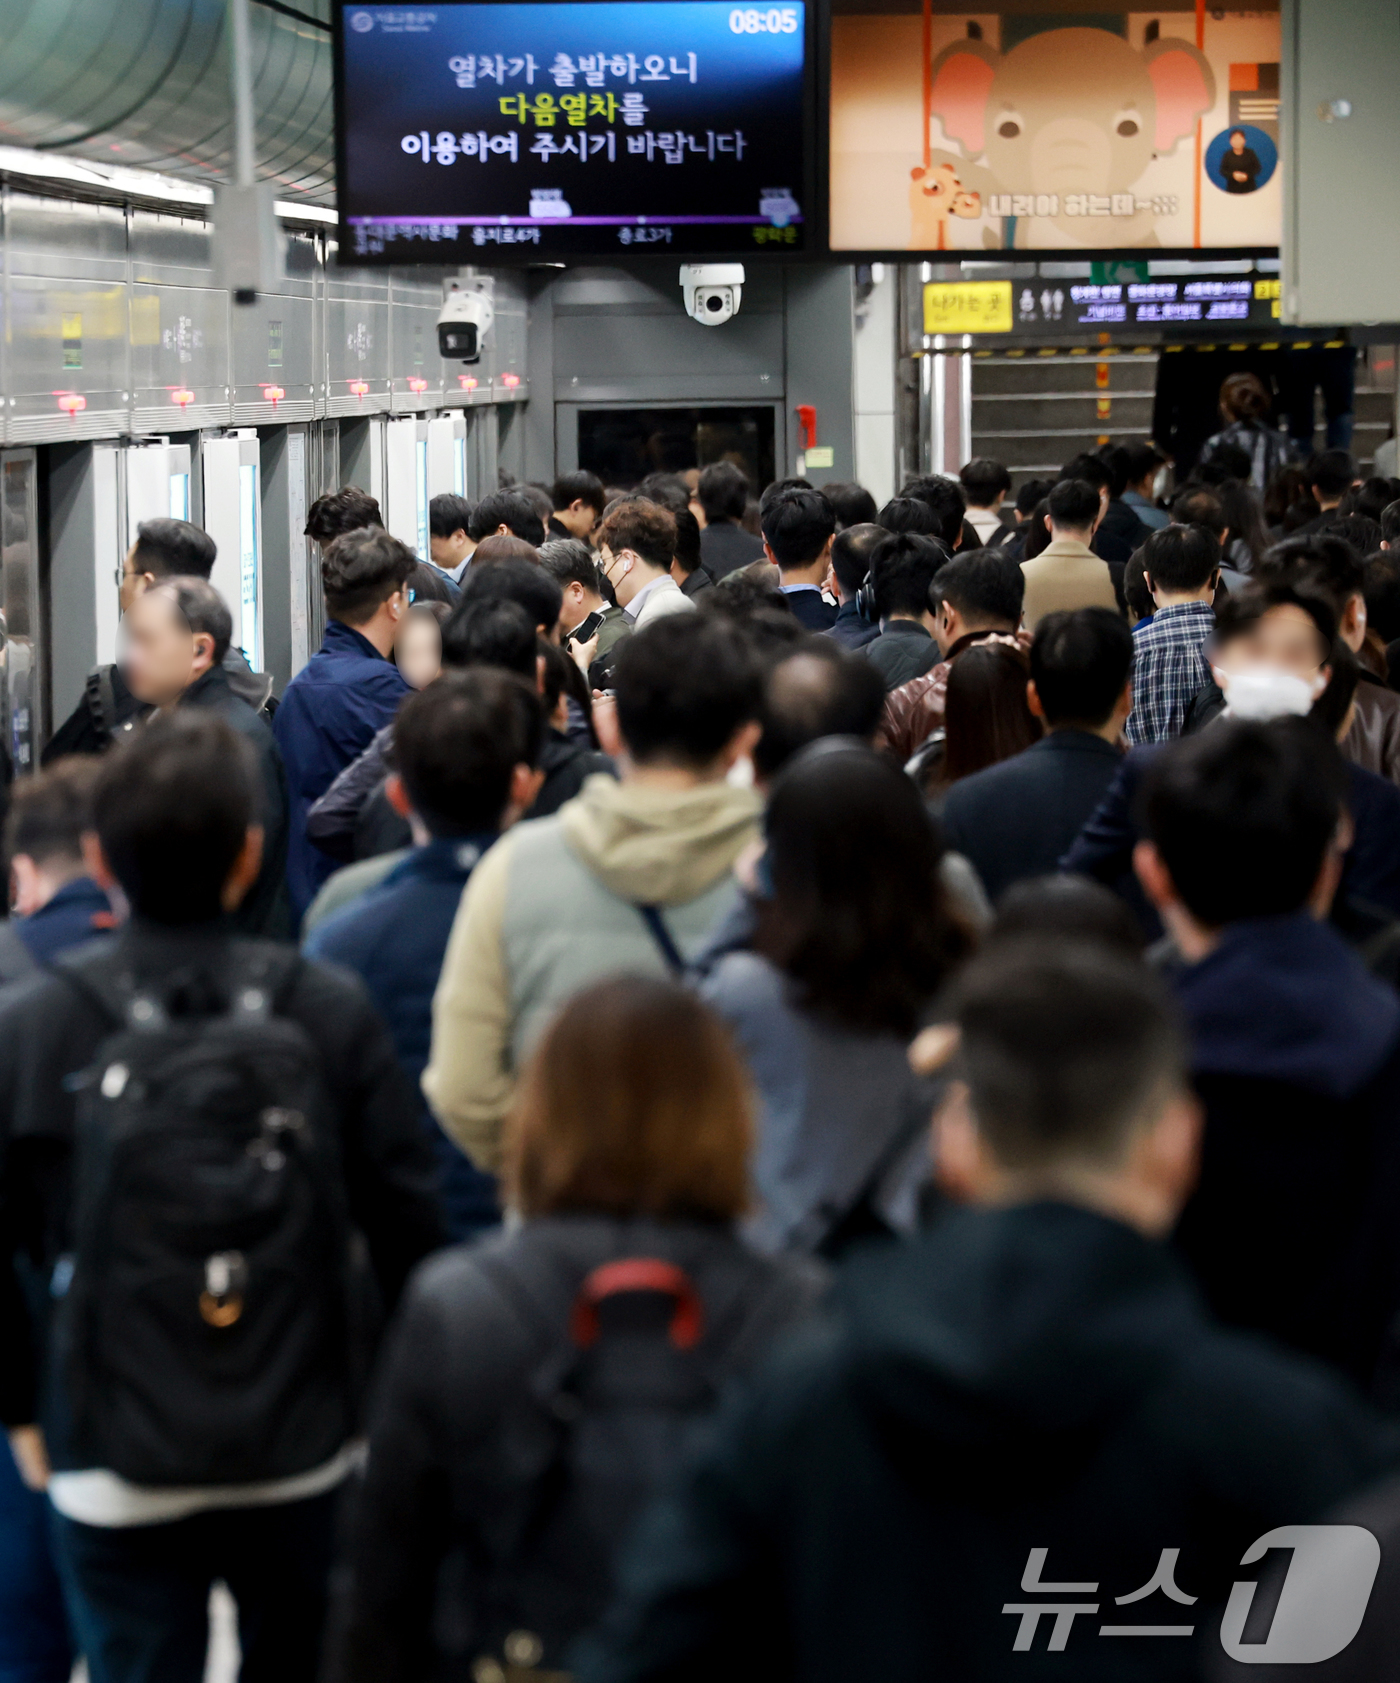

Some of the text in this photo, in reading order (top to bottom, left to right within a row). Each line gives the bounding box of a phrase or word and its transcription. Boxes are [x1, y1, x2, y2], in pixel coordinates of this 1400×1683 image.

[729, 9, 798, 34] 08:05
[448, 51, 698, 88] 열차가 출발하오니
[499, 92, 650, 126] 다음열차를
[401, 131, 748, 165] 이용하여 주시기 바랍니다
[990, 194, 1058, 217] 내려야
[931, 294, 980, 312] 나가는
